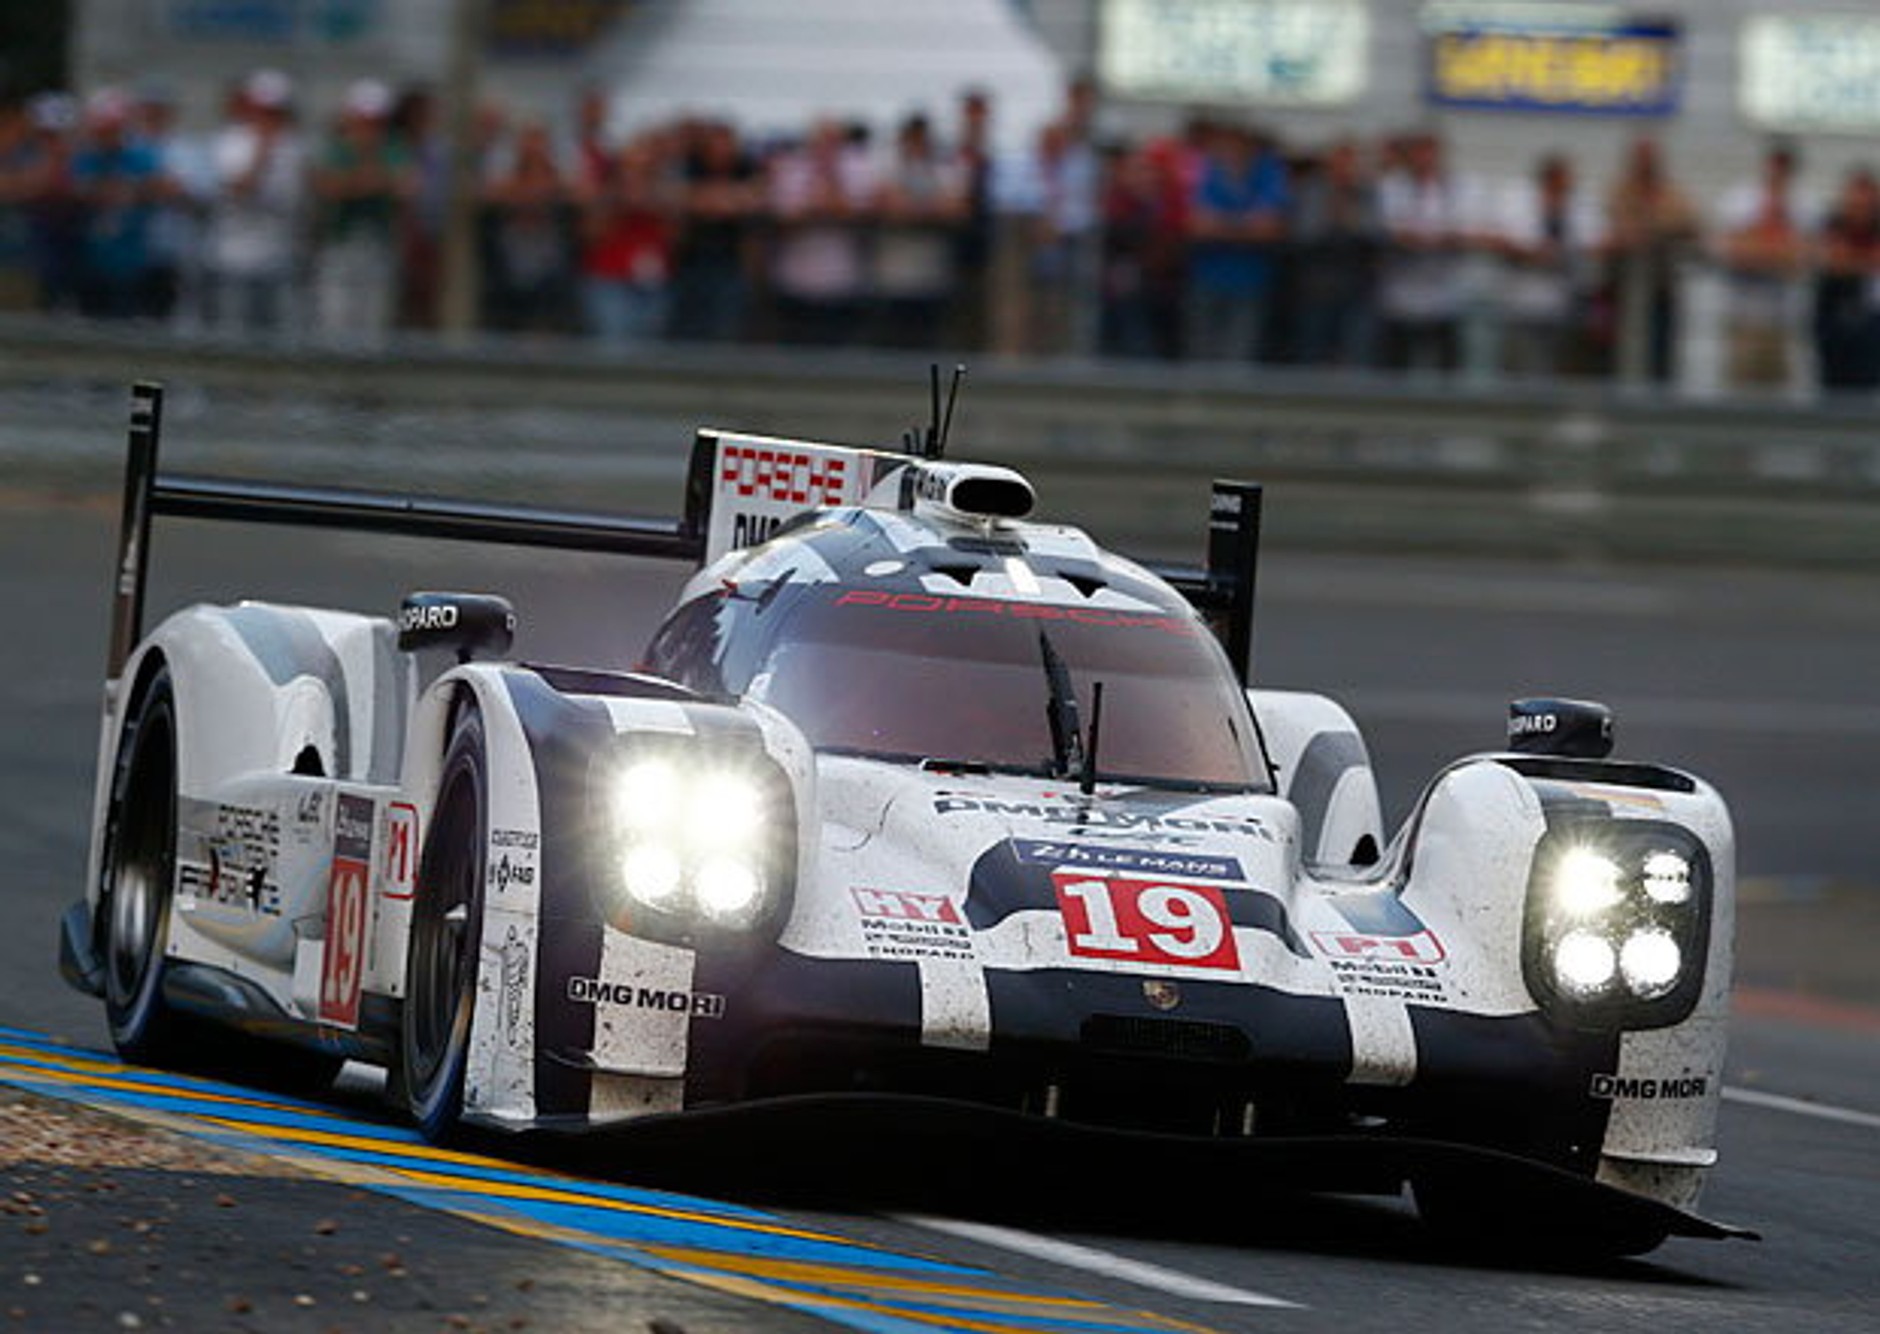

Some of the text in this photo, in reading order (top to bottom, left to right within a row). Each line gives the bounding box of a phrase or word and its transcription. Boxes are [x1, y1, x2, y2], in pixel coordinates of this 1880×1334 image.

[721, 445, 844, 506] PORSCHE
[834, 589, 1200, 637] PORSCHE
[856, 889, 949, 921] HY
[1062, 879, 1227, 961] 19
[325, 872, 363, 1007] 19
[1334, 937, 1421, 957] P1
[567, 976, 727, 1018] DMG MORI
[1591, 1074, 1657, 1100] DMG
